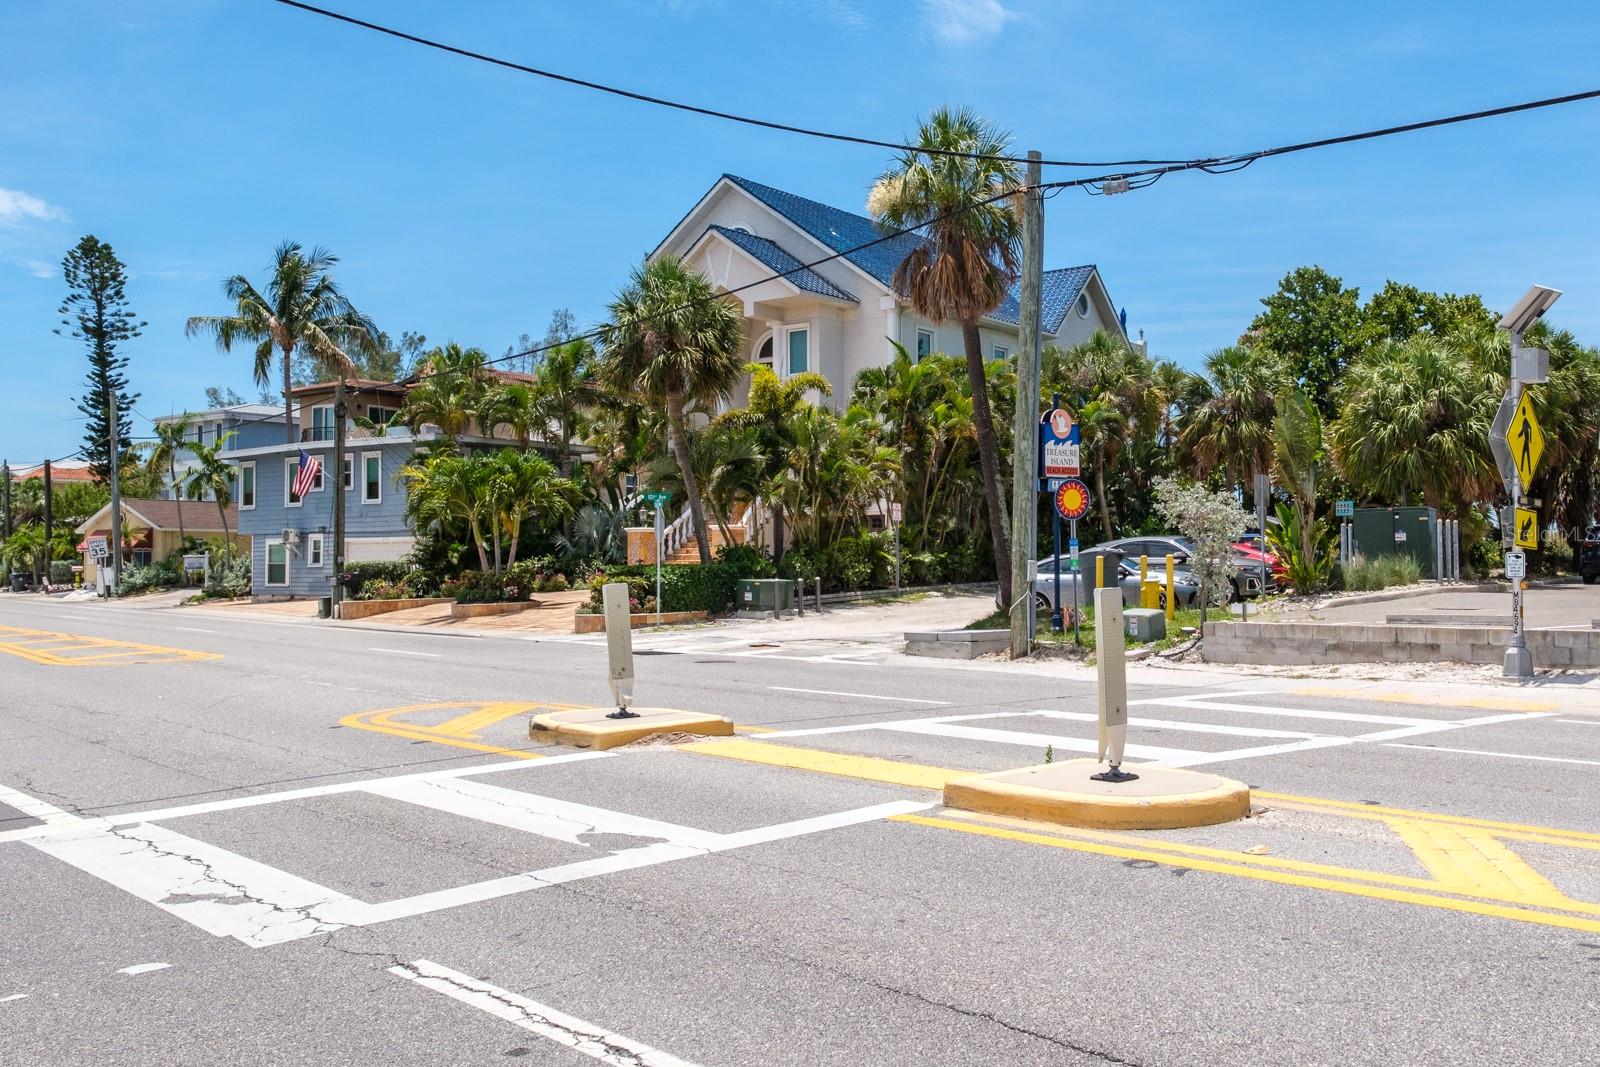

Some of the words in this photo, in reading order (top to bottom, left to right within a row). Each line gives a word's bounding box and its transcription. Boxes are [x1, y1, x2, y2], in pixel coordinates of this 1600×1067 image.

[1046, 448, 1078, 457] TREASURE
[1050, 458, 1074, 466] ISLAND
[91, 547, 107, 557] 35
